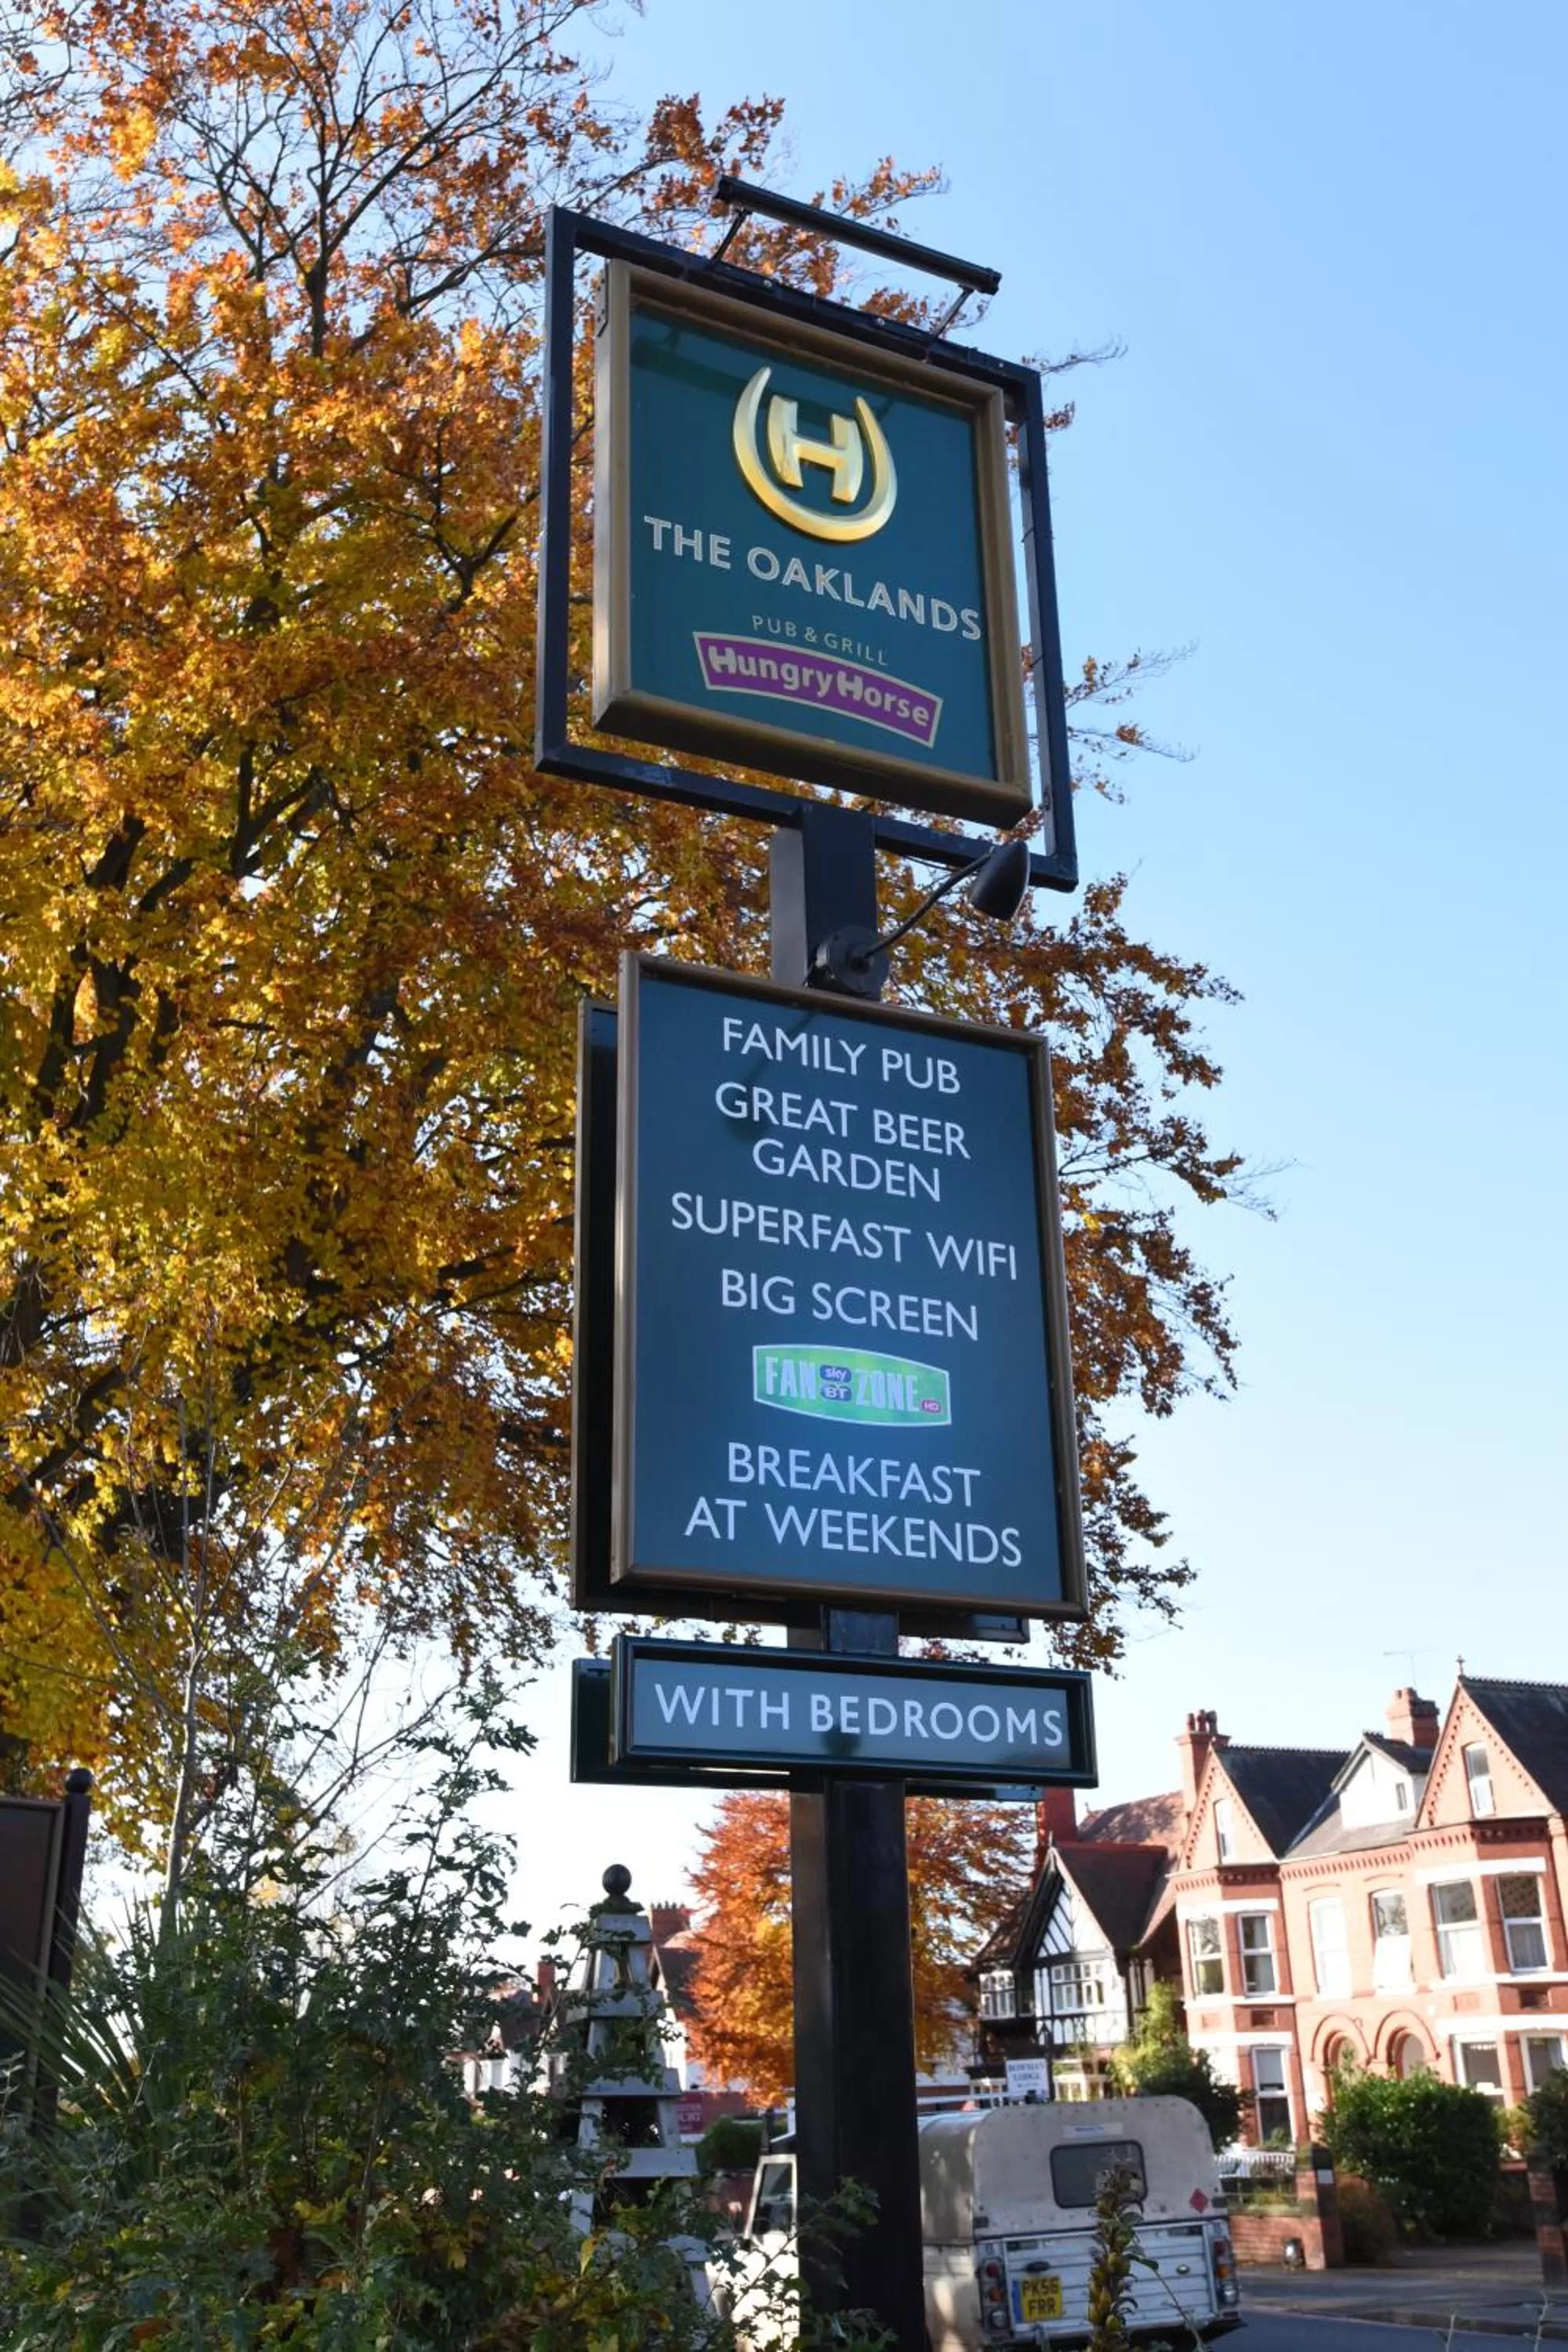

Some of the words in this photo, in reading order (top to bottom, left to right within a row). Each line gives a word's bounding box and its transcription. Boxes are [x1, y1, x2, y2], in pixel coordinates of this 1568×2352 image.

[644, 515, 731, 570] THE
[746, 546, 982, 641] OAKLANDS
[752, 615, 797, 637] PUB
[804, 626, 818, 643] &
[824, 633, 888, 666] GRILL
[723, 1017, 866, 1076] FAMILY
[882, 1047, 961, 1094] PUB
[715, 1082, 858, 1138] GREAT
[873, 1109, 971, 1159] BEER
[753, 1138, 941, 1203] GARDEN
[671, 1192, 911, 1262] SUPERFAST
[926, 1232, 1018, 1281] WIFI
[721, 1269, 796, 1315] BIG
[812, 1282, 978, 1341] SCREEN
[764, 1356, 817, 1400] FAN
[855, 1368, 920, 1413] ZONE
[825, 1367, 848, 1383] sky
[728, 1442, 981, 1507] BREAKFAST
[684, 1496, 747, 1541] AT
[765, 1502, 1022, 1567] WEEKENDS
[655, 1683, 790, 1731] WITH
[810, 1693, 1063, 1748] BEDROOMS
